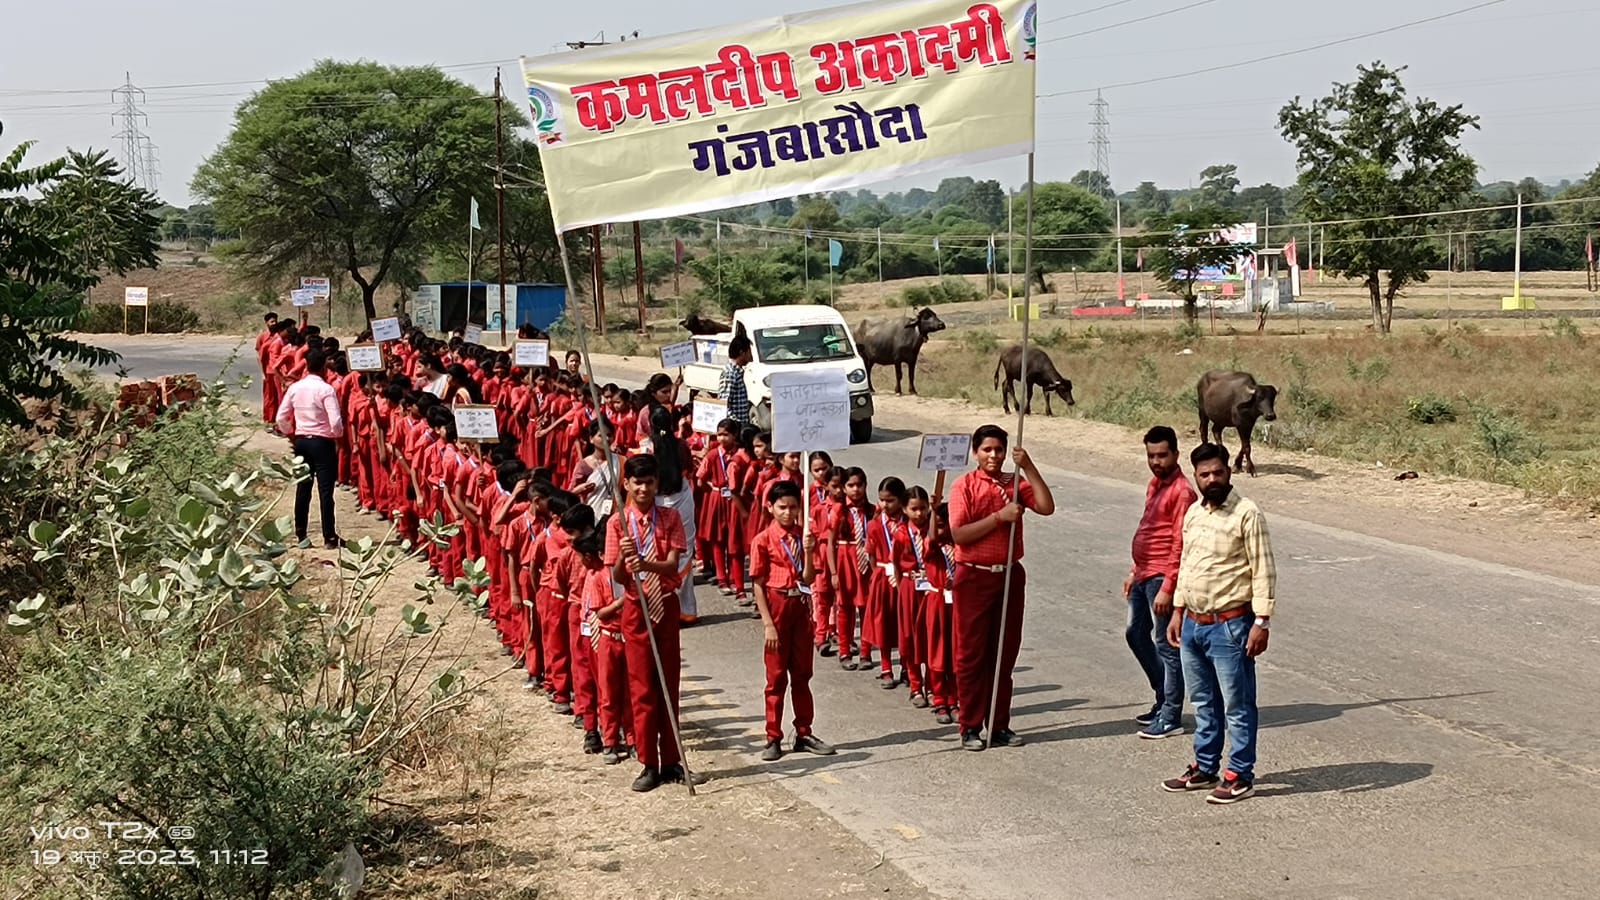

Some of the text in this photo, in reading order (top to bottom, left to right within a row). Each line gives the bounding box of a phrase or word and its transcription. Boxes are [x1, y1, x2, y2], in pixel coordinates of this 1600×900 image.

[570, 43, 800, 133] कमलदीप
[810, 3, 1012, 94] अकादमी
[688, 102, 928, 176] गंजबासौदा
